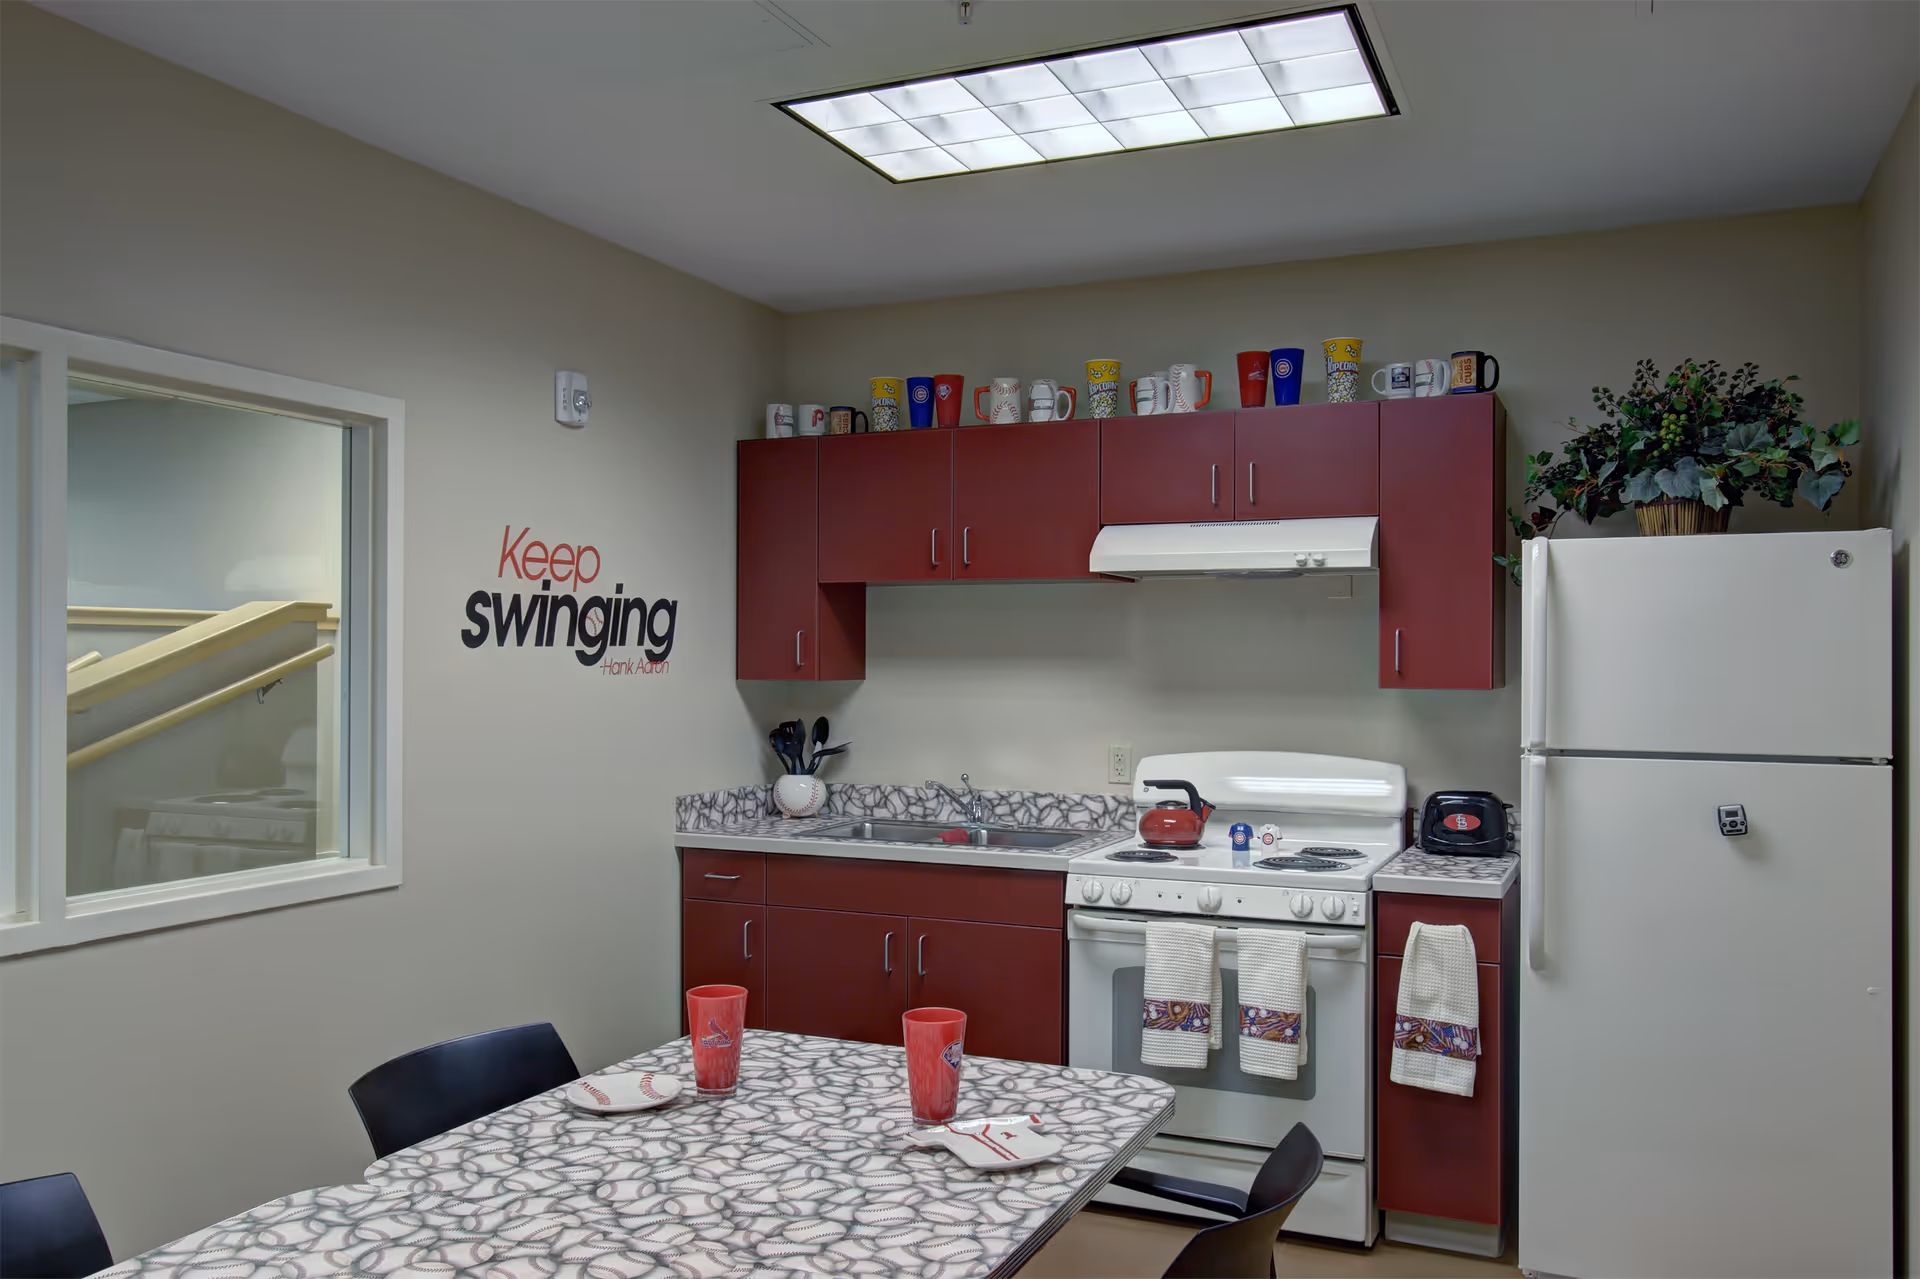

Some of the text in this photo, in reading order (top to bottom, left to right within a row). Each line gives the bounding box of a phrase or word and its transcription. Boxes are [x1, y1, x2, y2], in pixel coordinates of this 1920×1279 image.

[1464, 358, 1472, 384] CUBS
[498, 525, 601, 592] Keep
[461, 579, 678, 666] swinging
[634, 657, 670, 675] Aaron
